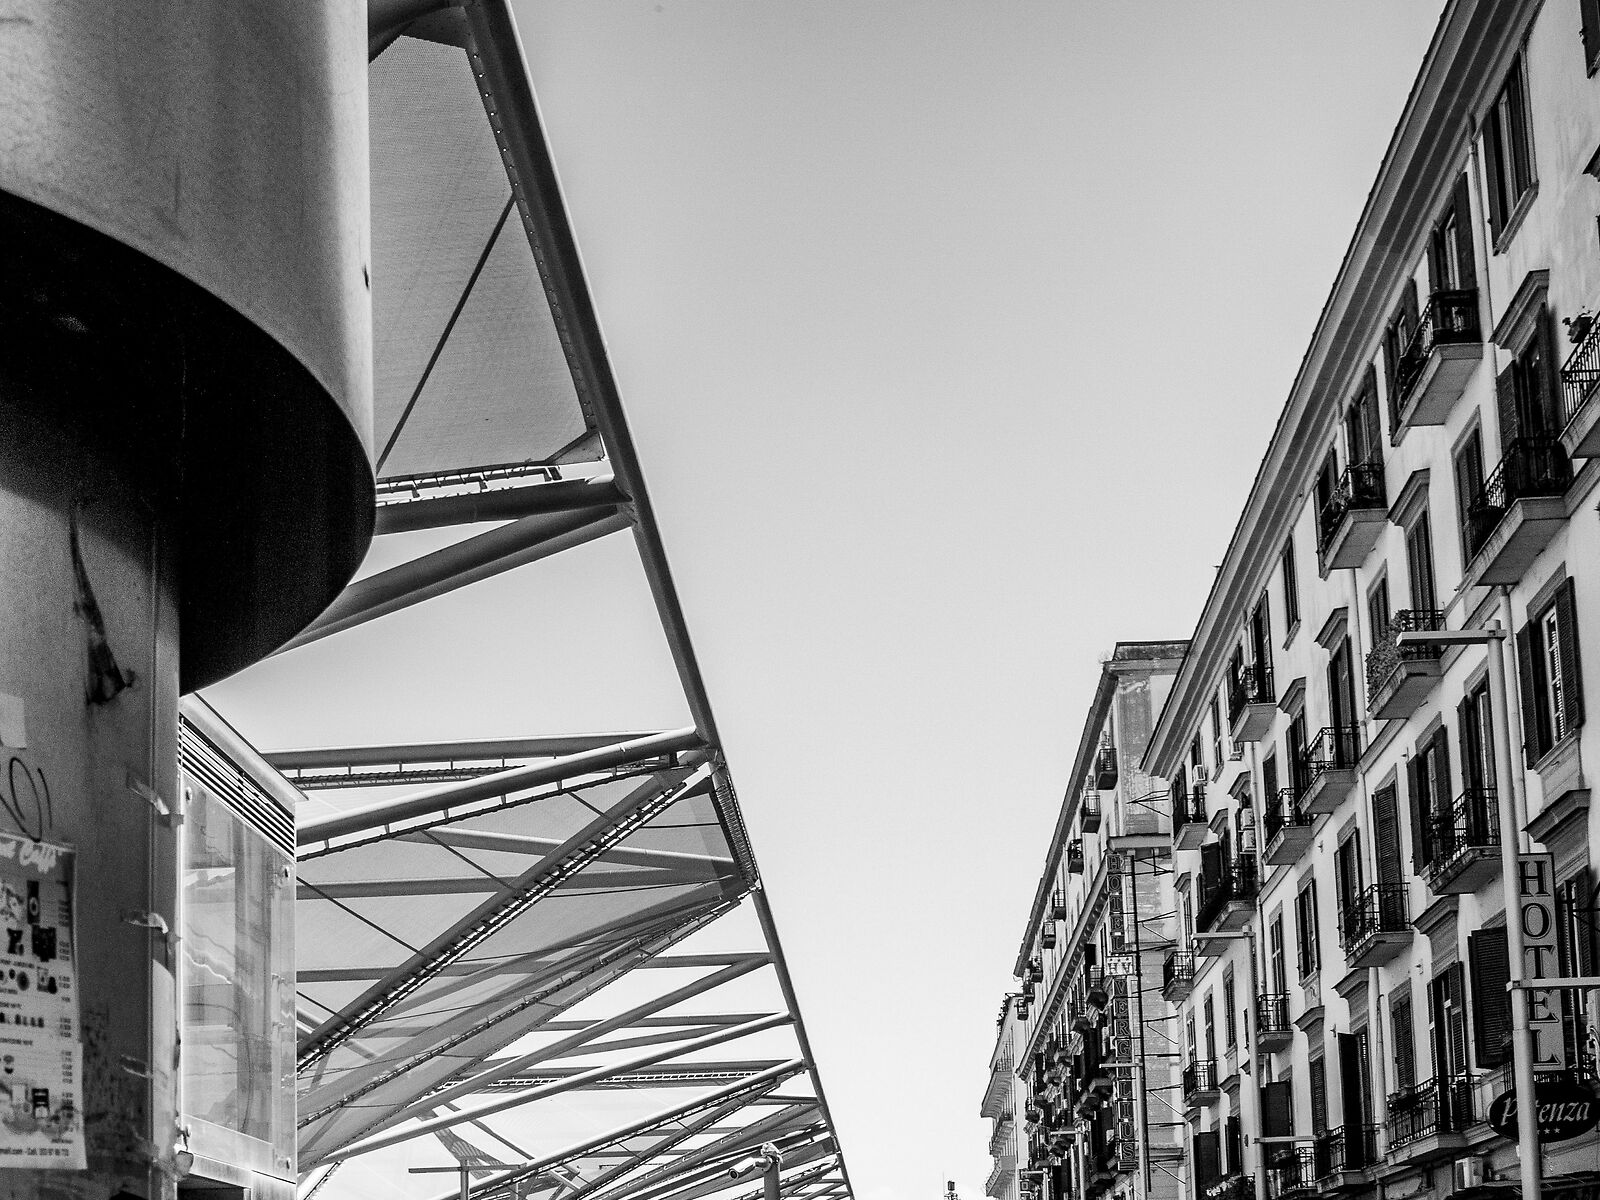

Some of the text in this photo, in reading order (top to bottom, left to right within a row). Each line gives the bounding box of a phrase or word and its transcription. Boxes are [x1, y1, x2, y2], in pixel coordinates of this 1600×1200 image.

[1107, 854, 1125, 952] HOTEL
[1519, 859, 1562, 1067] HOTEL
[1114, 978, 1137, 1161] VERGILIUS
